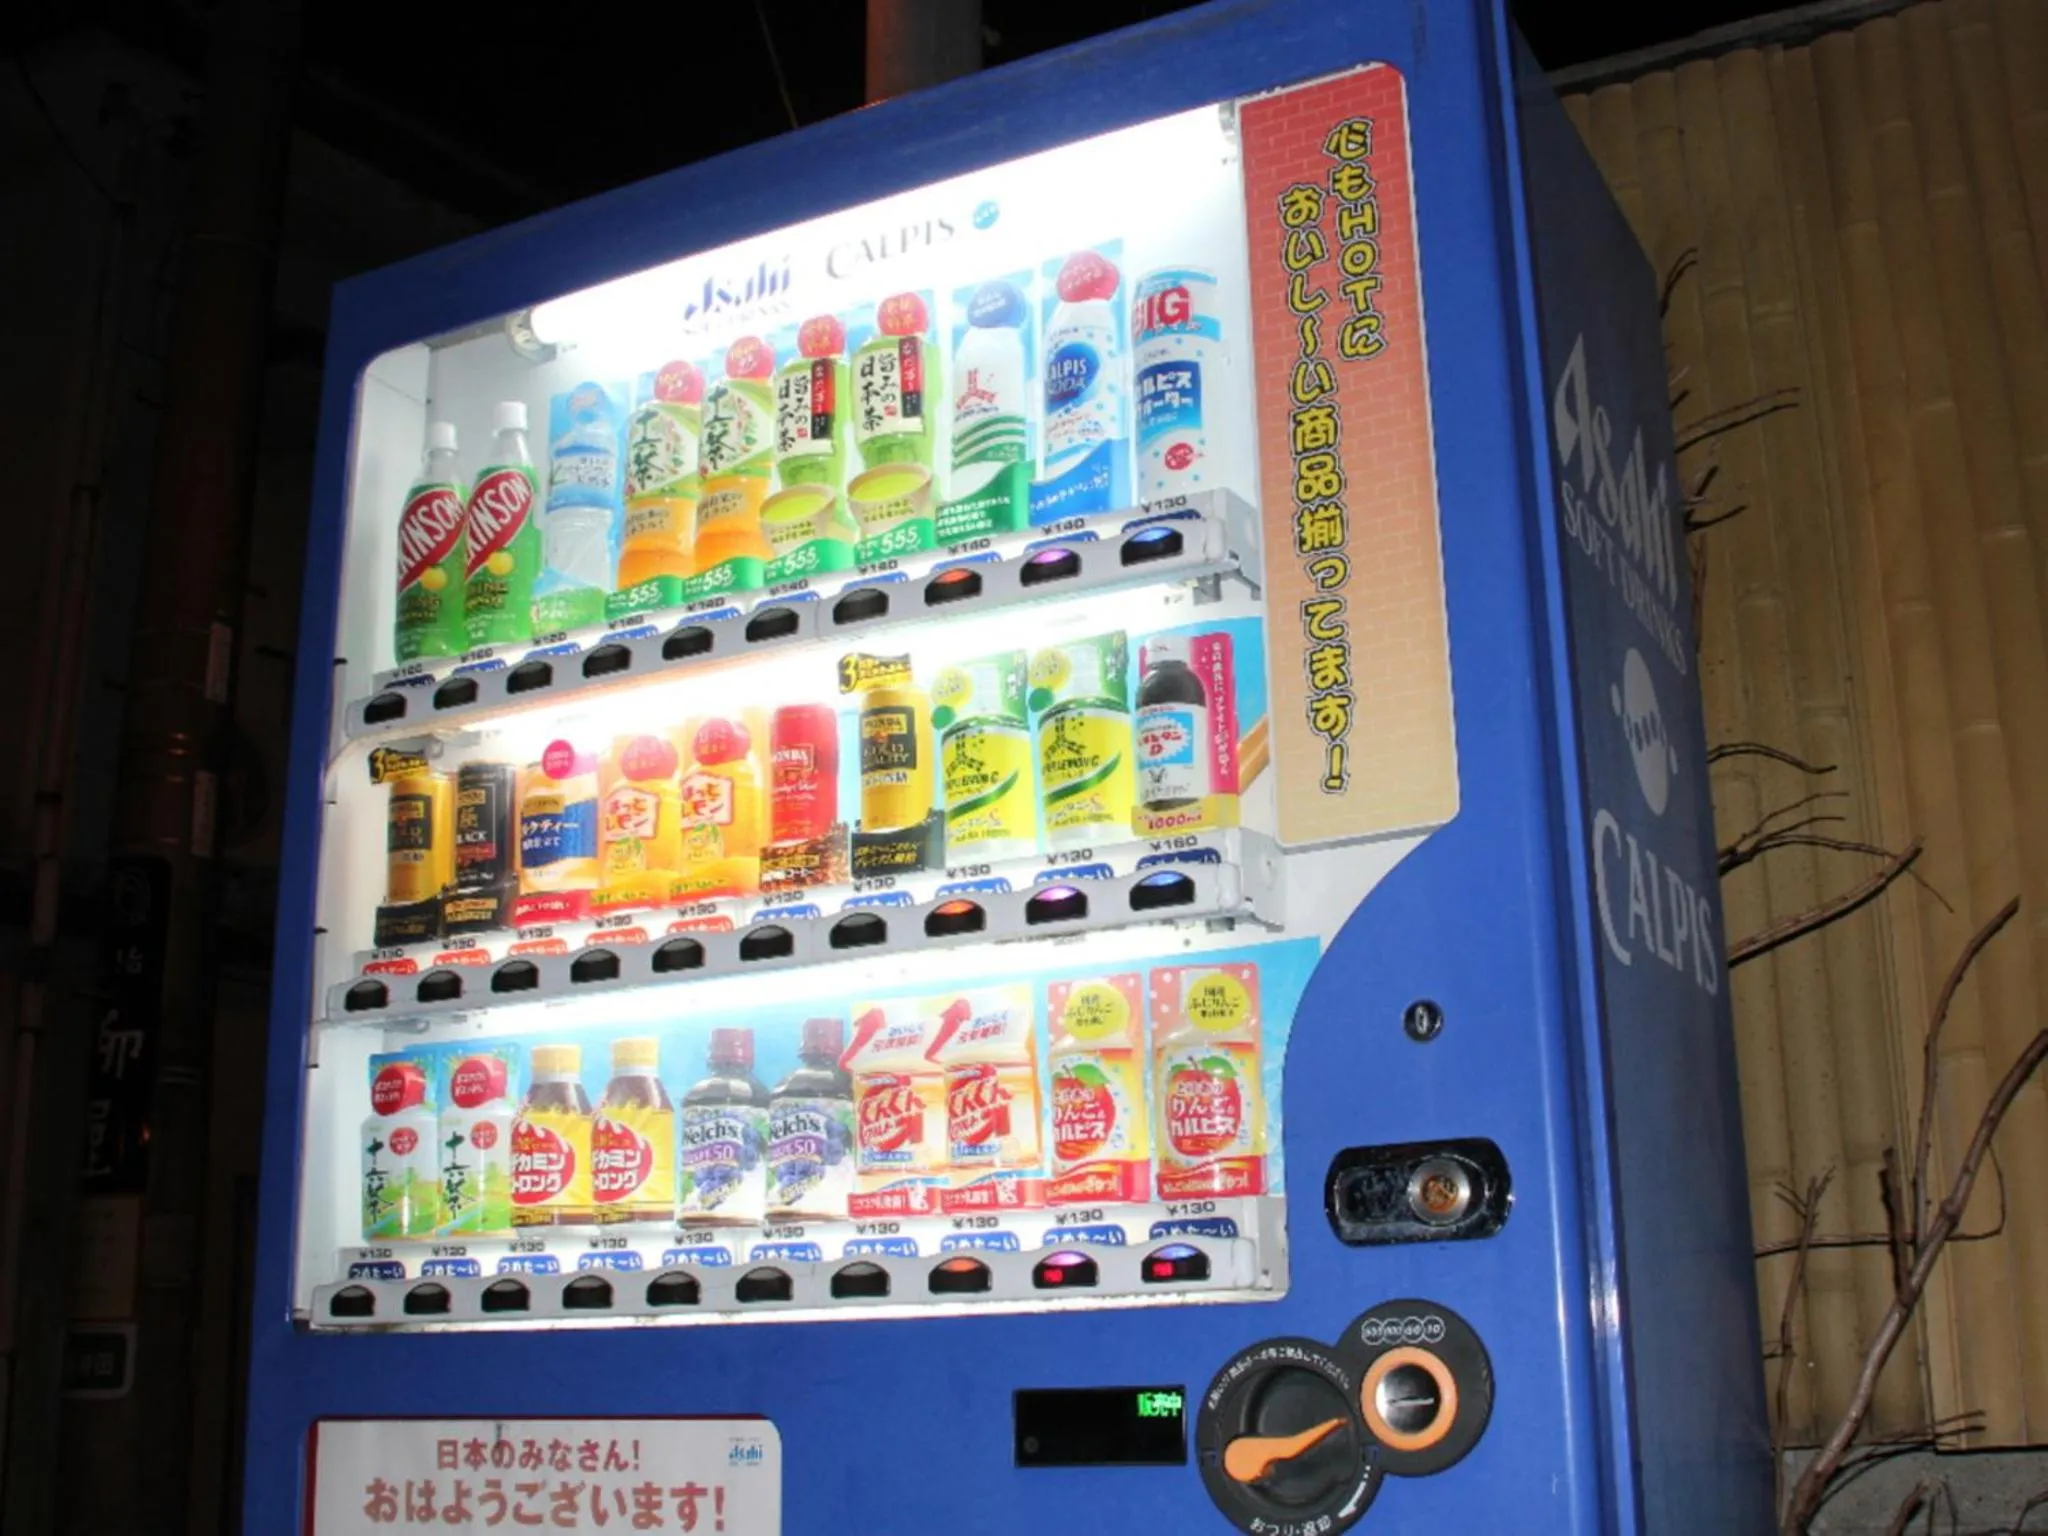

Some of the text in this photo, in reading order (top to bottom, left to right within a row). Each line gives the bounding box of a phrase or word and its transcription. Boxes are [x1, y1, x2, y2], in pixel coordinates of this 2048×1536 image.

[826, 218, 955, 279] CALPIS
[1324, 118, 1386, 360] 心もHOTに
[861, 355, 884, 432] 日本茶
[1048, 358, 1086, 382] ALPIS
[777, 377, 796, 452] 日本茶
[1555, 332, 1680, 610] Asahi
[1562, 480, 1616, 587] SOFT
[1593, 808, 1718, 995] CALPIS
[1171, 1115, 1236, 1137] カルピス
[366, 1137, 394, 1225] 十六茶
[443, 1131, 477, 1221] 十六茶
[436, 1438, 641, 1472] 日本のみなさん!
[364, 1477, 727, 1533] おはようございます!
